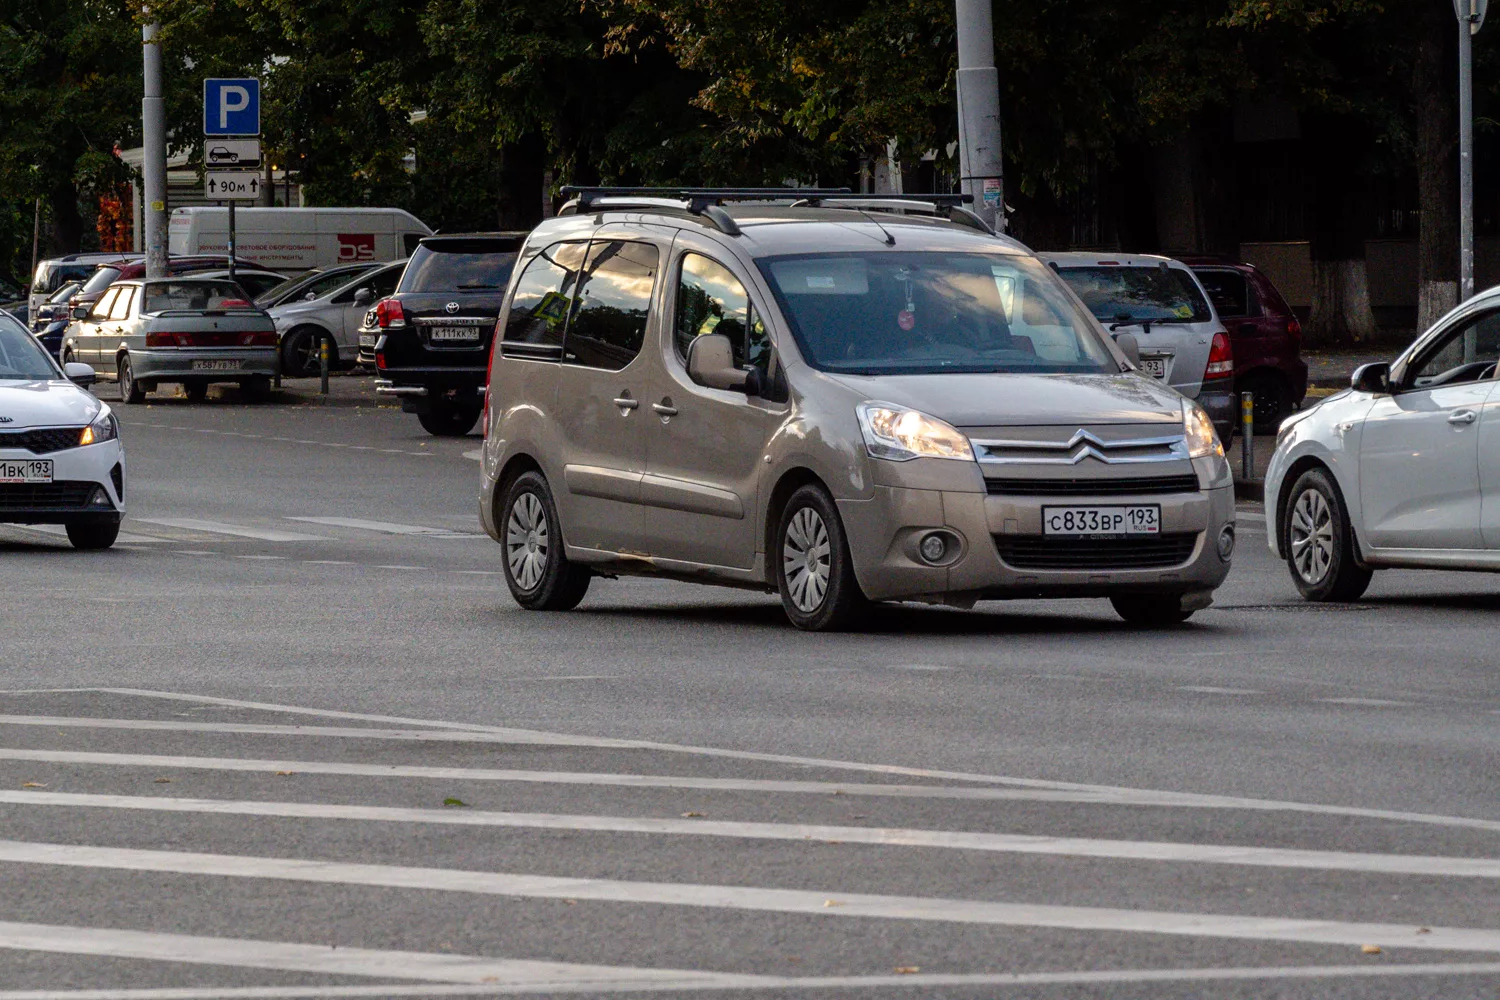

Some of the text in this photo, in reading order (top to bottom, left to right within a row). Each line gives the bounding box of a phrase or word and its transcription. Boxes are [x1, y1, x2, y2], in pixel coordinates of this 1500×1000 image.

[220, 85, 250, 129] P
[1146, 361, 1159, 371] 93
[28, 462, 49, 473] 193
[1050, 509, 1154, 531] С833ВР 193
